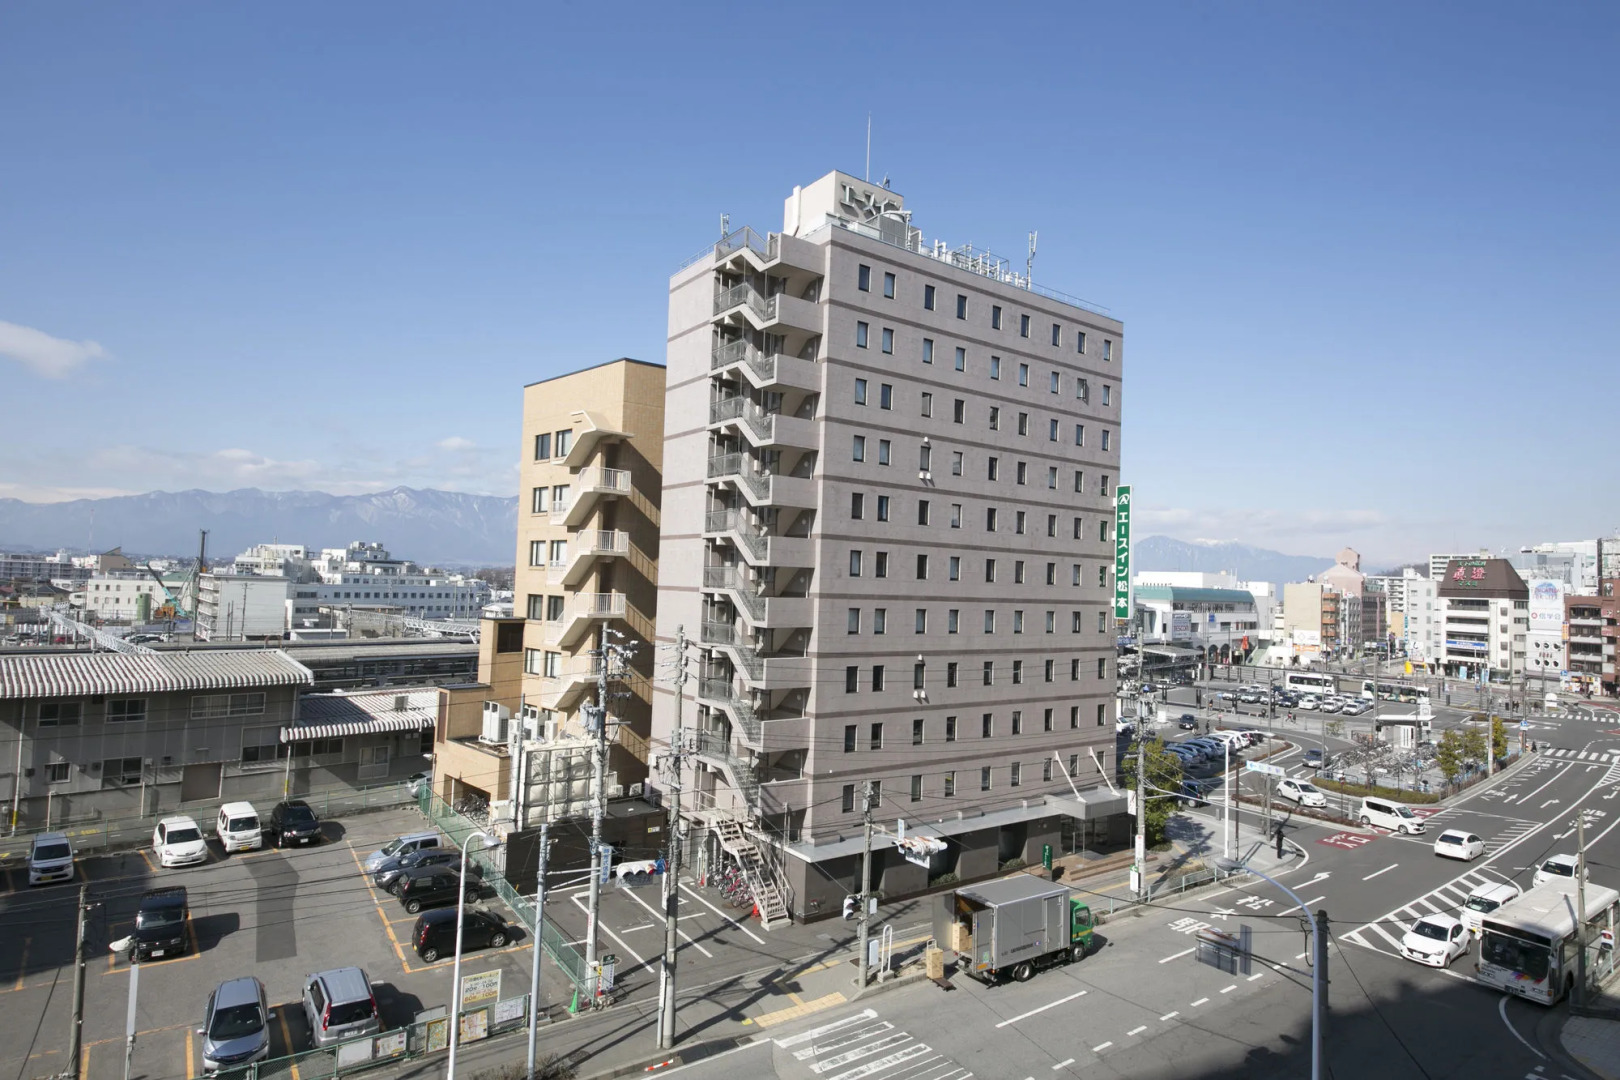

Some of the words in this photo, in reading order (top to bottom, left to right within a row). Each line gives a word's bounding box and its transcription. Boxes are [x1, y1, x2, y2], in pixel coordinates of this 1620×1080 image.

[1116, 512, 1129, 609] エースイン松本
